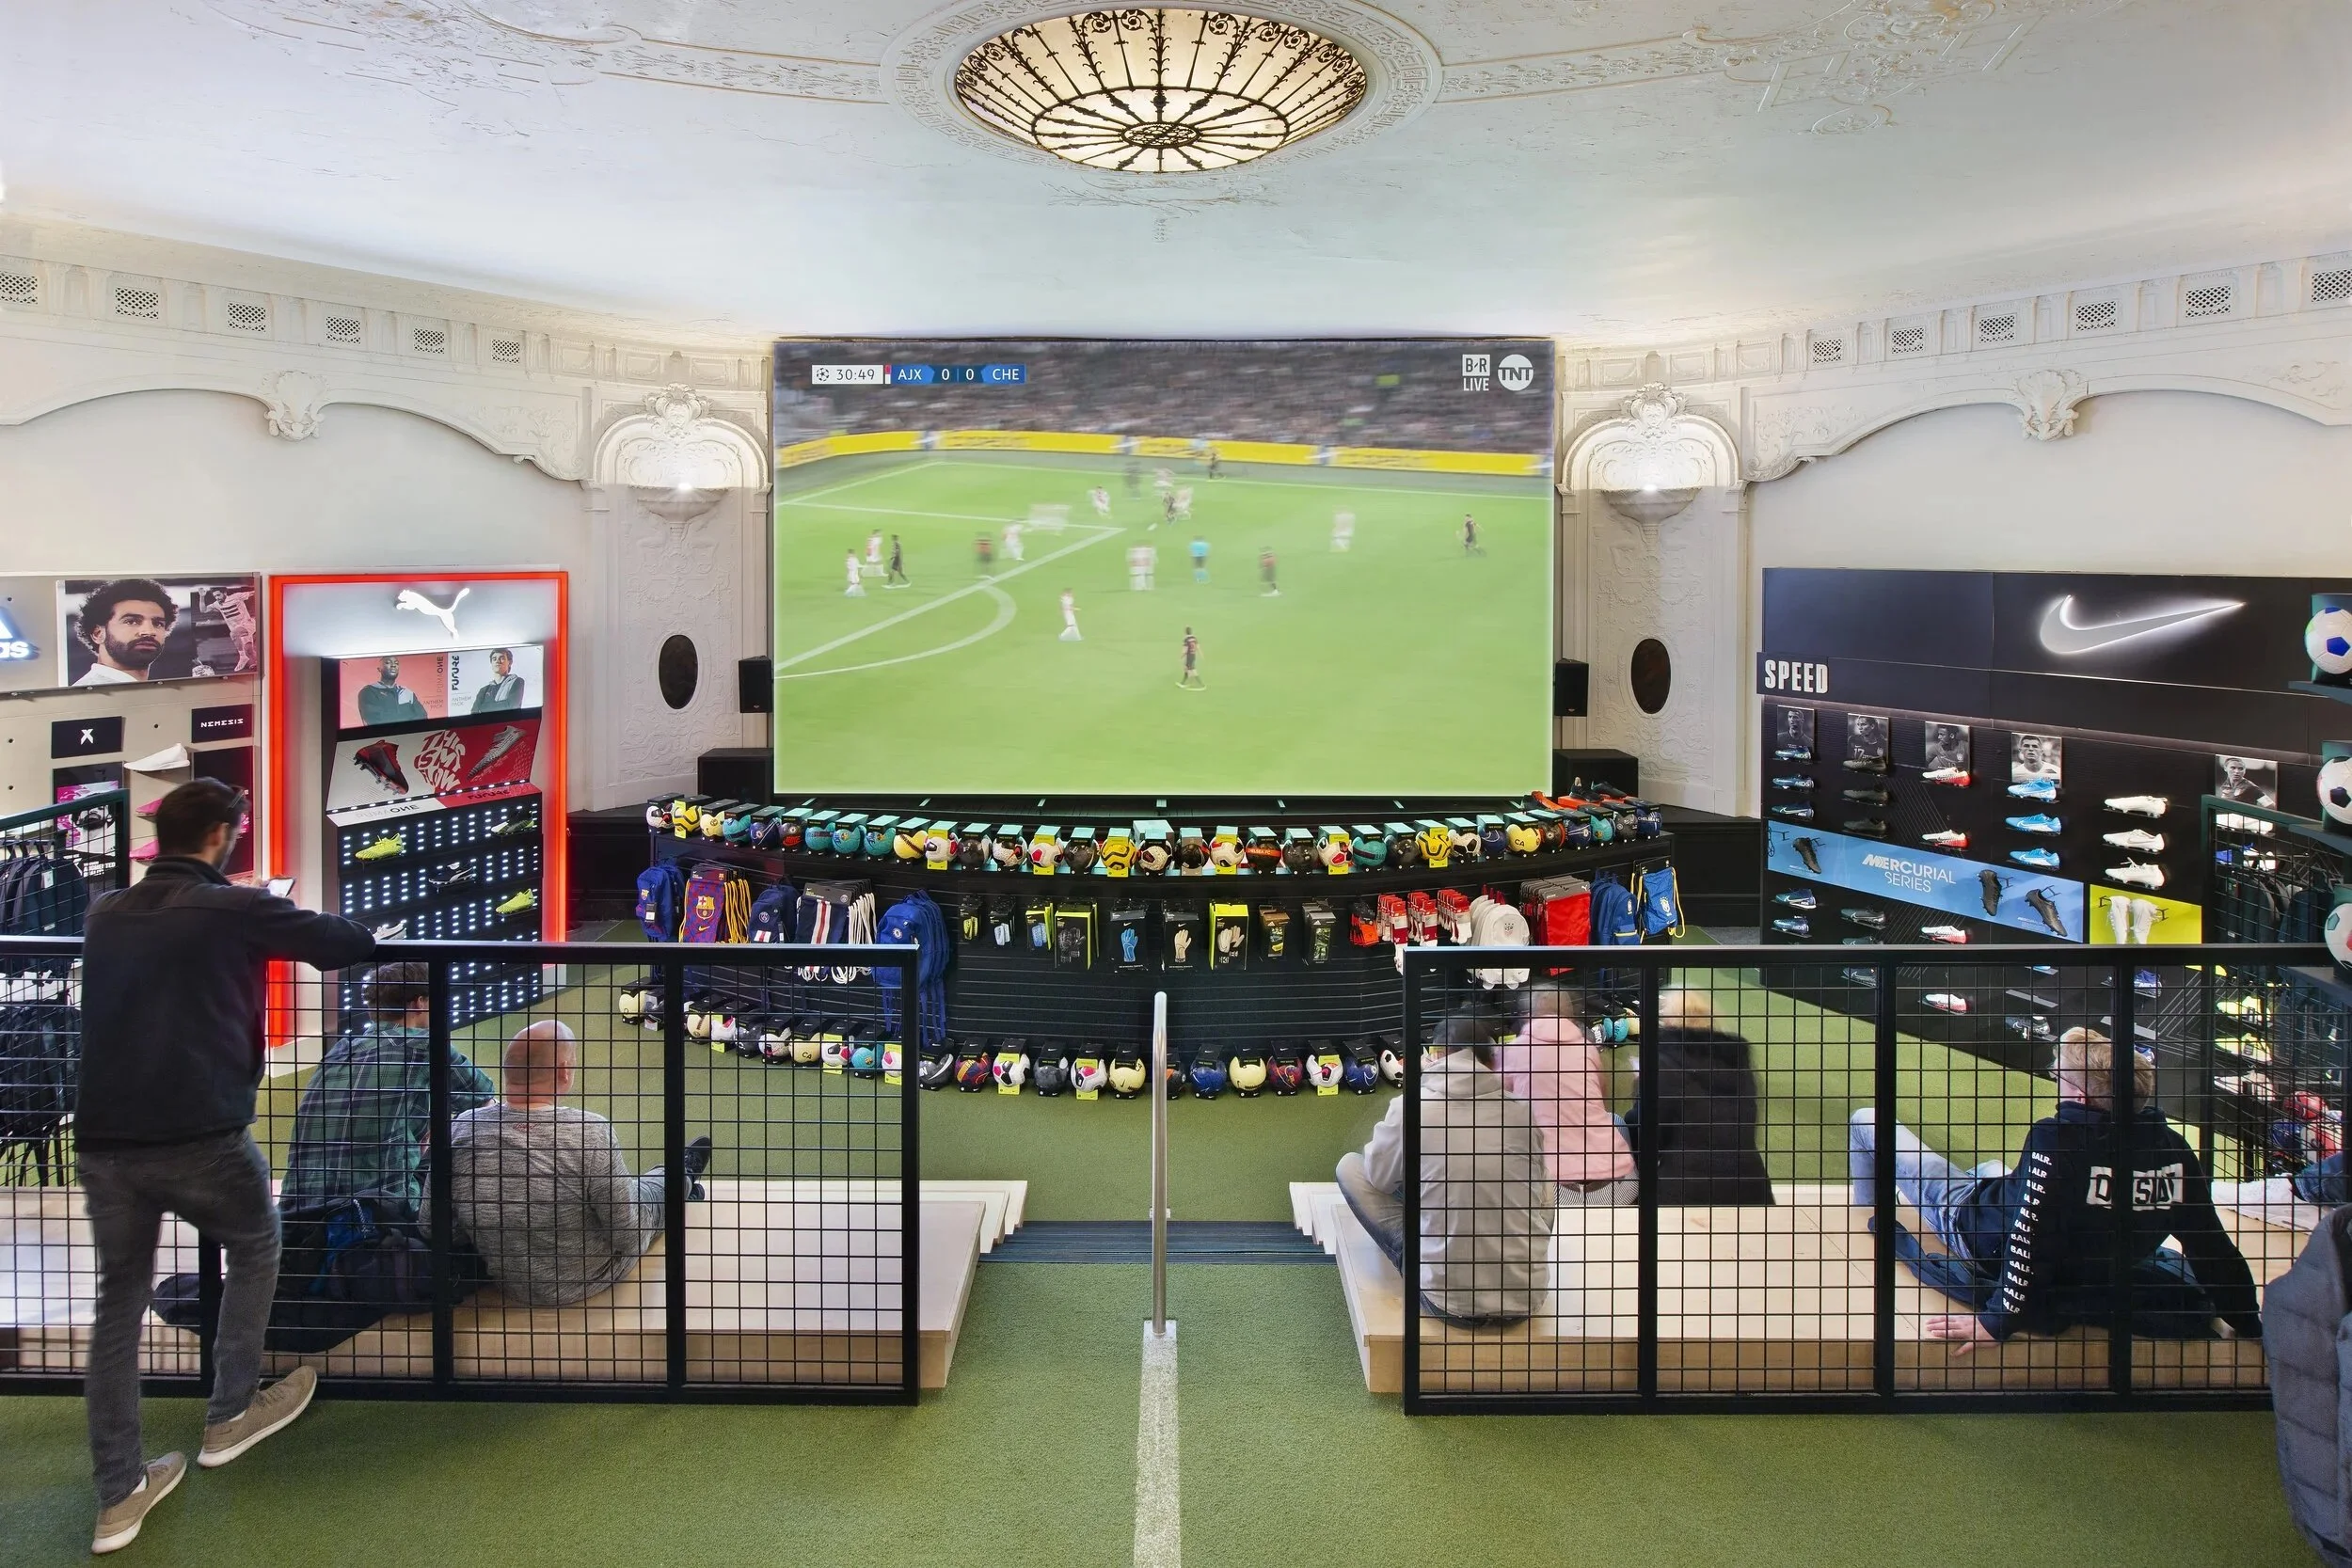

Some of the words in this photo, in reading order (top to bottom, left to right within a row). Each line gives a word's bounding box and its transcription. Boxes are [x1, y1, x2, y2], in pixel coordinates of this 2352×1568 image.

[835, 368, 875, 381] 30:49
[898, 368, 922, 381] AJX
[942, 368, 950, 381] 0
[966, 368, 975, 381] 0
[992, 368, 1020, 381] CHE
[1500, 366, 1533, 381] TNT
[1463, 377, 1489, 391] LIVE
[1764, 659, 1828, 694] SPEED
[200, 718, 244, 728] NEMESIS
[80, 729, 94, 745] X
[1862, 853, 1957, 885] MERCURIAL
[1884, 871, 1931, 893] SERIES
